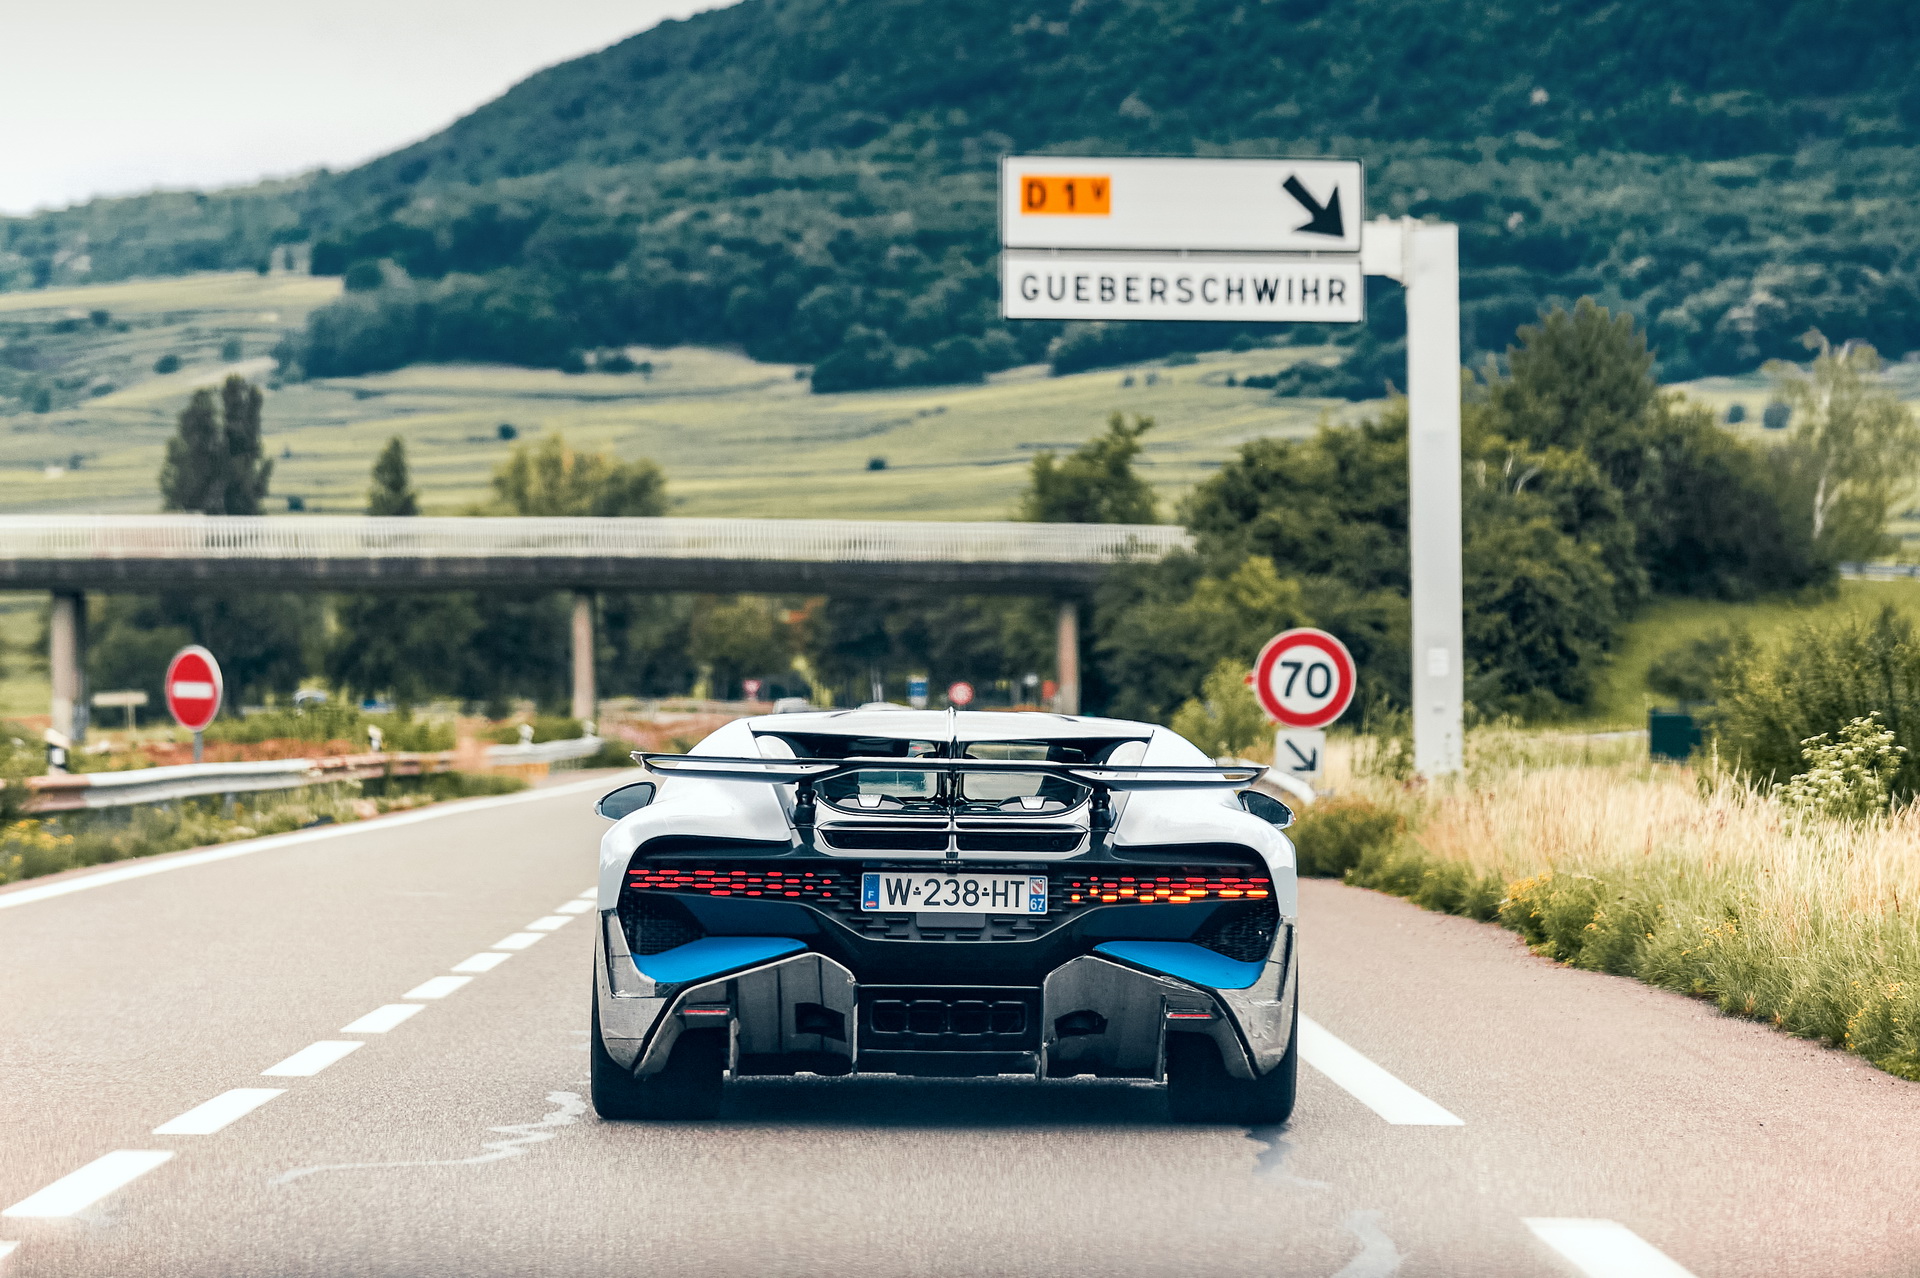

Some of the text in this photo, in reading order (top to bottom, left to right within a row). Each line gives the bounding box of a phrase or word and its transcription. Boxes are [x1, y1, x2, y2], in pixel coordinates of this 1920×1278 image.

[1020, 274, 1347, 305] GUEBERSCHWIHR
[1280, 661, 1332, 699] 70
[868, 890, 875, 900] F
[885, 877, 1026, 908] W-238-HT
[1030, 897, 1045, 911] 67
